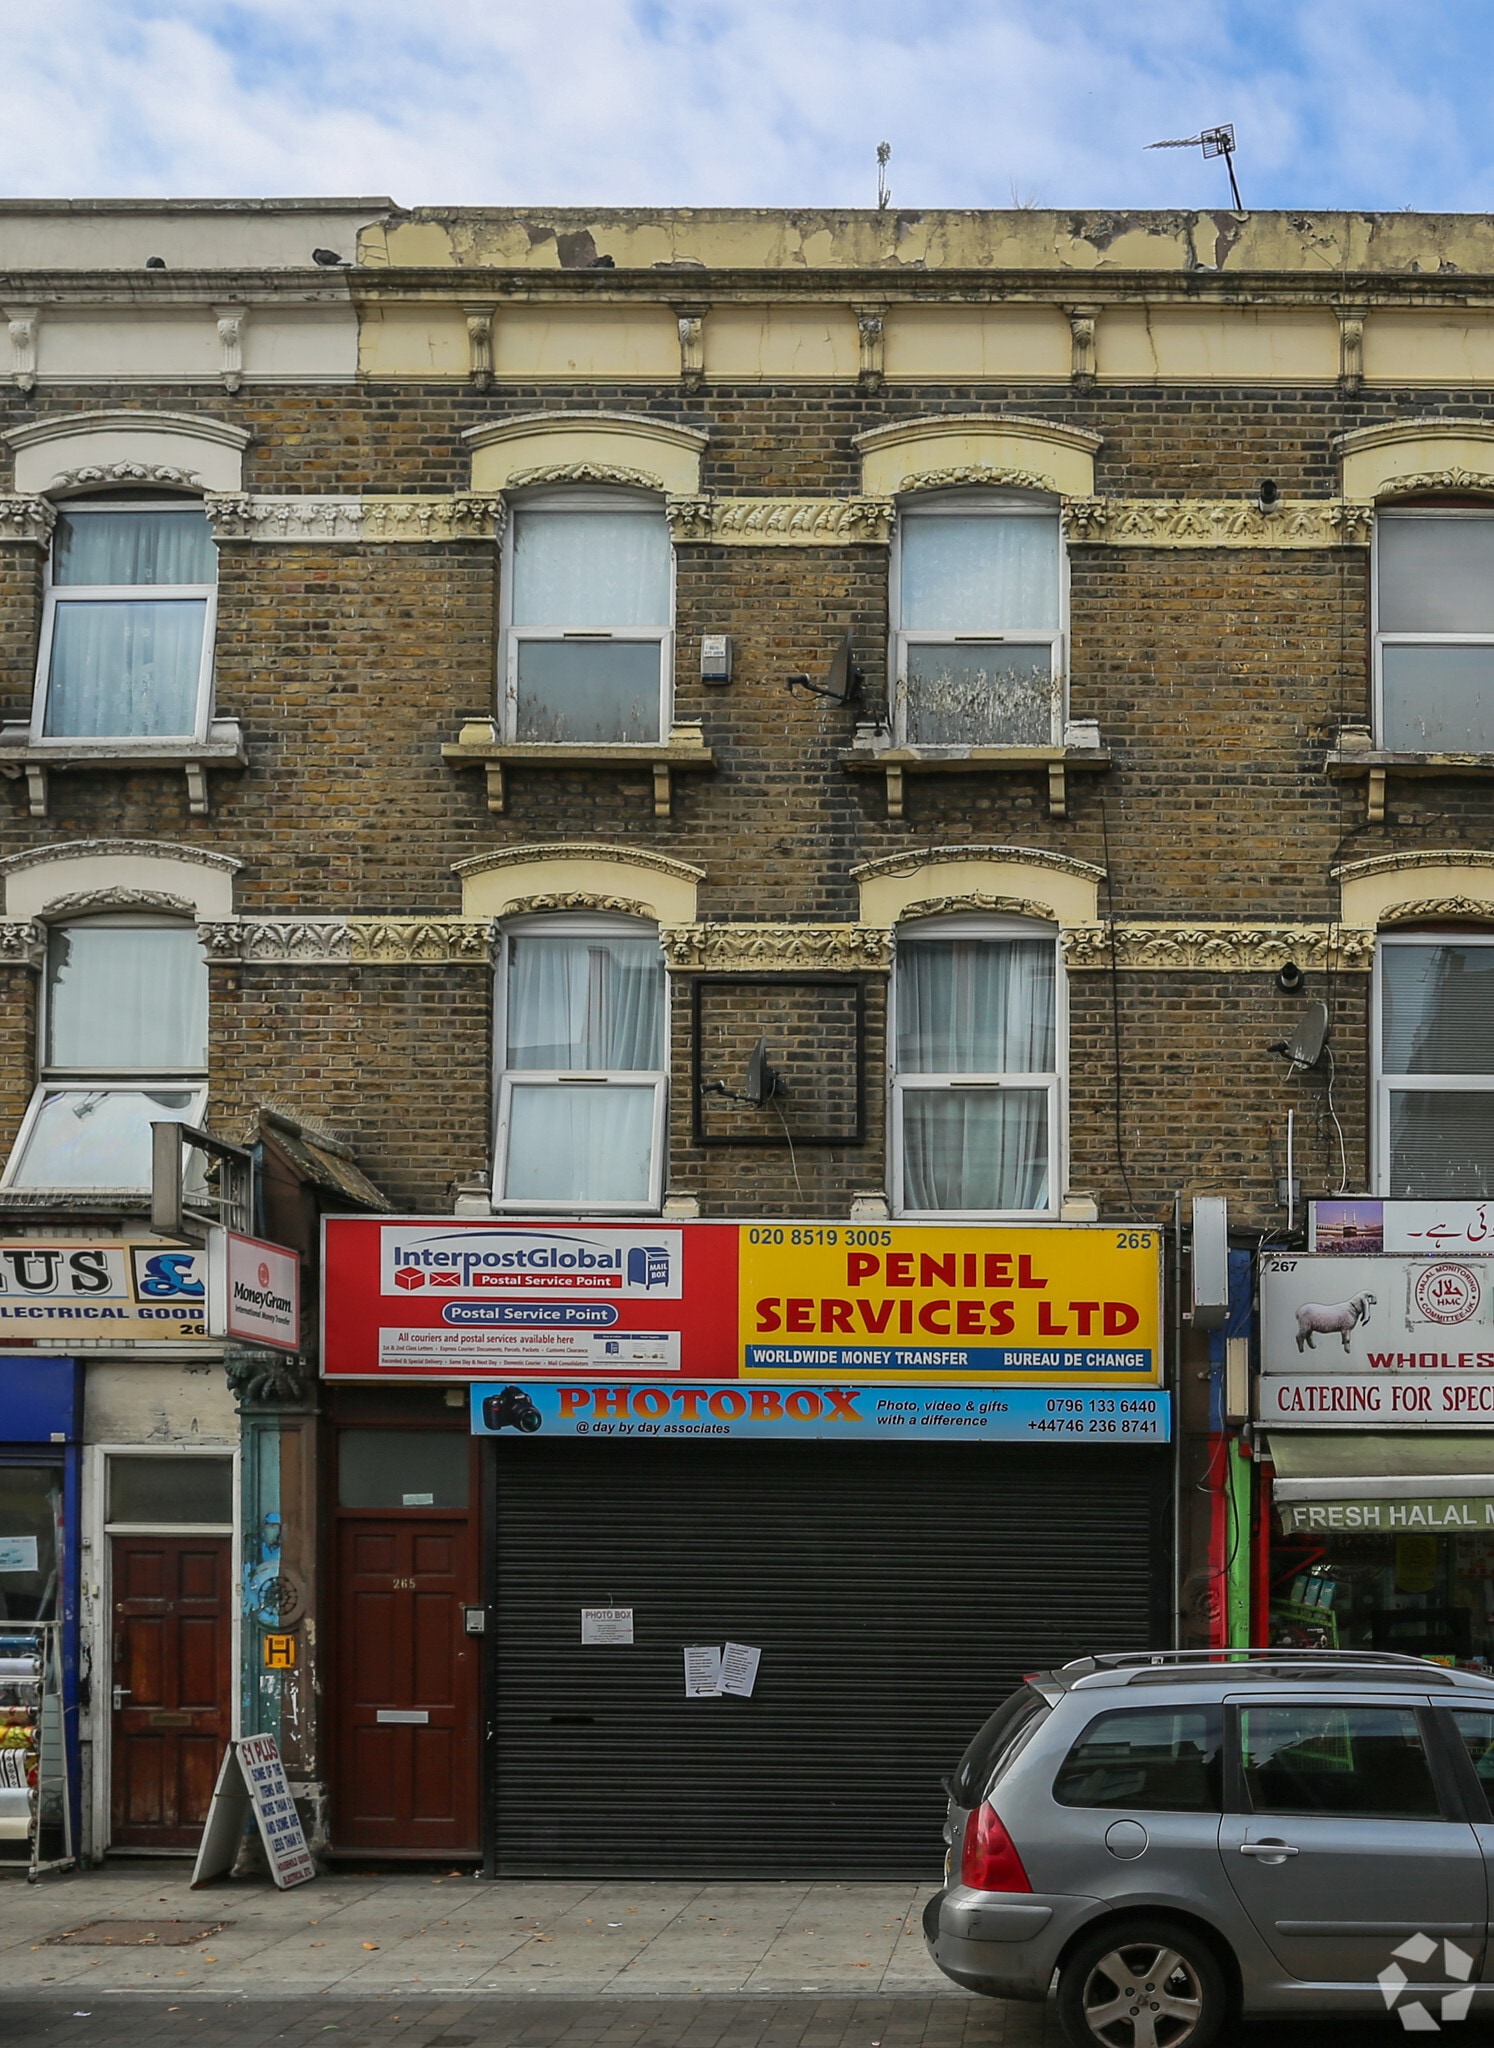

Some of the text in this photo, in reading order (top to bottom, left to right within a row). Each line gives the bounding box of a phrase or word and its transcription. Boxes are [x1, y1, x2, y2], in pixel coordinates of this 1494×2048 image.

[750, 1228, 892, 1246] 020 8519 3005
[1116, 1233, 1151, 1249] 265
[0, 1251, 112, 1295] US
[394, 1246, 622, 1287] InterpostGlobal
[649, 1263, 668, 1271] MAIL
[847, 1252, 1048, 1289] PENIEL
[1271, 1261, 1297, 1272] 267
[481, 1275, 611, 1286] Postal Service Point
[1419, 1265, 1477, 1294] HALAL MONITORING
[1432, 1279, 1463, 1298] حلال
[233, 1281, 291, 1313] MoneyGram
[1437, 1298, 1461, 1306] HMC
[138, 1308, 204, 1319] GOOD
[451, 1307, 608, 1320] Postal Service Point
[755, 1297, 1140, 1337] SERVICES LTD
[1422, 1302, 1475, 1322] COMMITTEE-UK
[179, 1324, 206, 1335] 26
[398, 1332, 575, 1345] All couriers and postal services available here
[753, 1349, 968, 1366] WORLDWIDE MONEY TRANSFER
[1004, 1352, 1144, 1367] BUREAU DE CHANGE
[1367, 1353, 1494, 1368] WHOLES
[556, 1387, 864, 1422] PHOTOBOX
[1046, 1399, 1156, 1413] 0796 133 6440
[1277, 1386, 1381, 1411] CATERING
[1391, 1386, 1432, 1411] FOR
[877, 1400, 1009, 1415] Photo, video & gifts
[877, 1415, 988, 1426] with a difference
[1028, 1419, 1157, 1433] +44746 236 8741
[576, 1422, 731, 1435] @ day by day associates
[1293, 1506, 1381, 1527] FRESH
[1389, 1504, 1478, 1526] HALAL
[393, 1578, 416, 1589] 265
[585, 1610, 632, 1619] PHOTO BOX
[254, 1738, 279, 1763] PLUS
[251, 1766, 267, 1782] SOME
